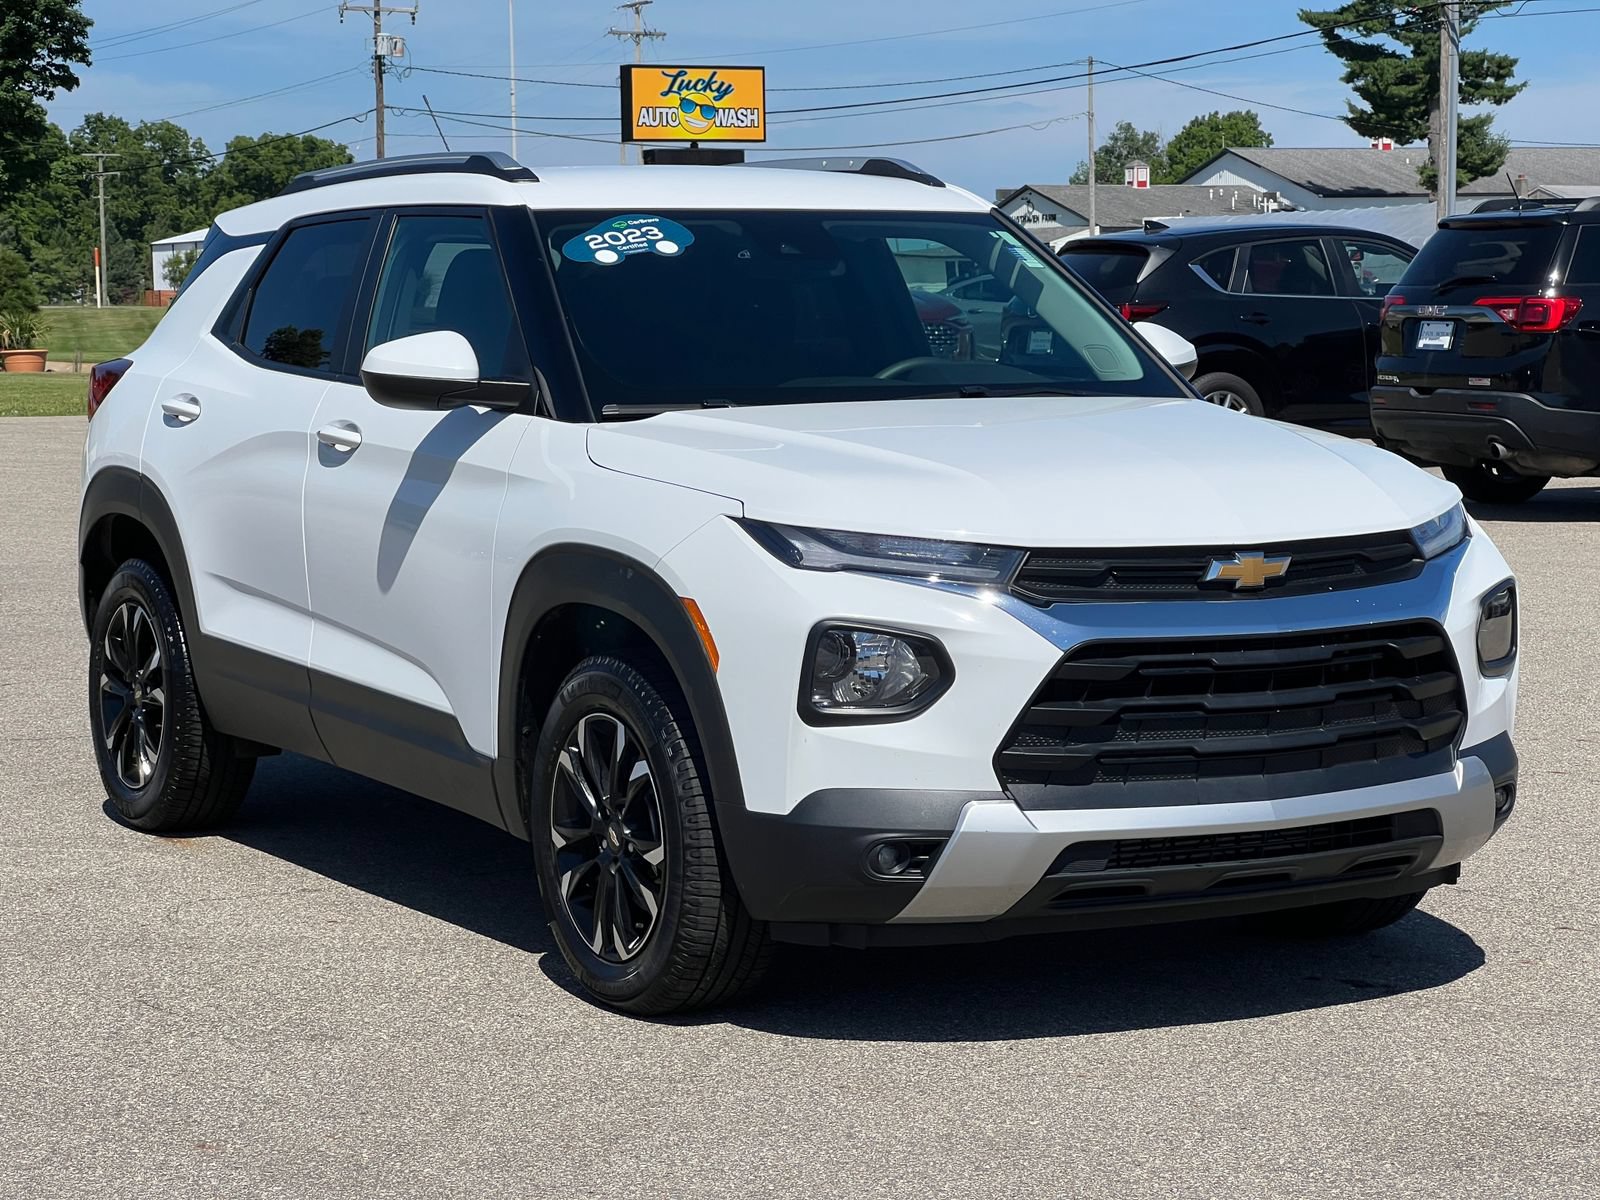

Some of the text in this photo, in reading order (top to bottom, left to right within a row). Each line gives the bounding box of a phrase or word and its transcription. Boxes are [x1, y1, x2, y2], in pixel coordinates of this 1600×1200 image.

[660, 70, 735, 101] Lucky
[637, 106, 759, 128] AUTO WASH
[584, 226, 664, 250] 2023
[617, 242, 649, 251] Certified
[1417, 305, 1449, 316] GMC
